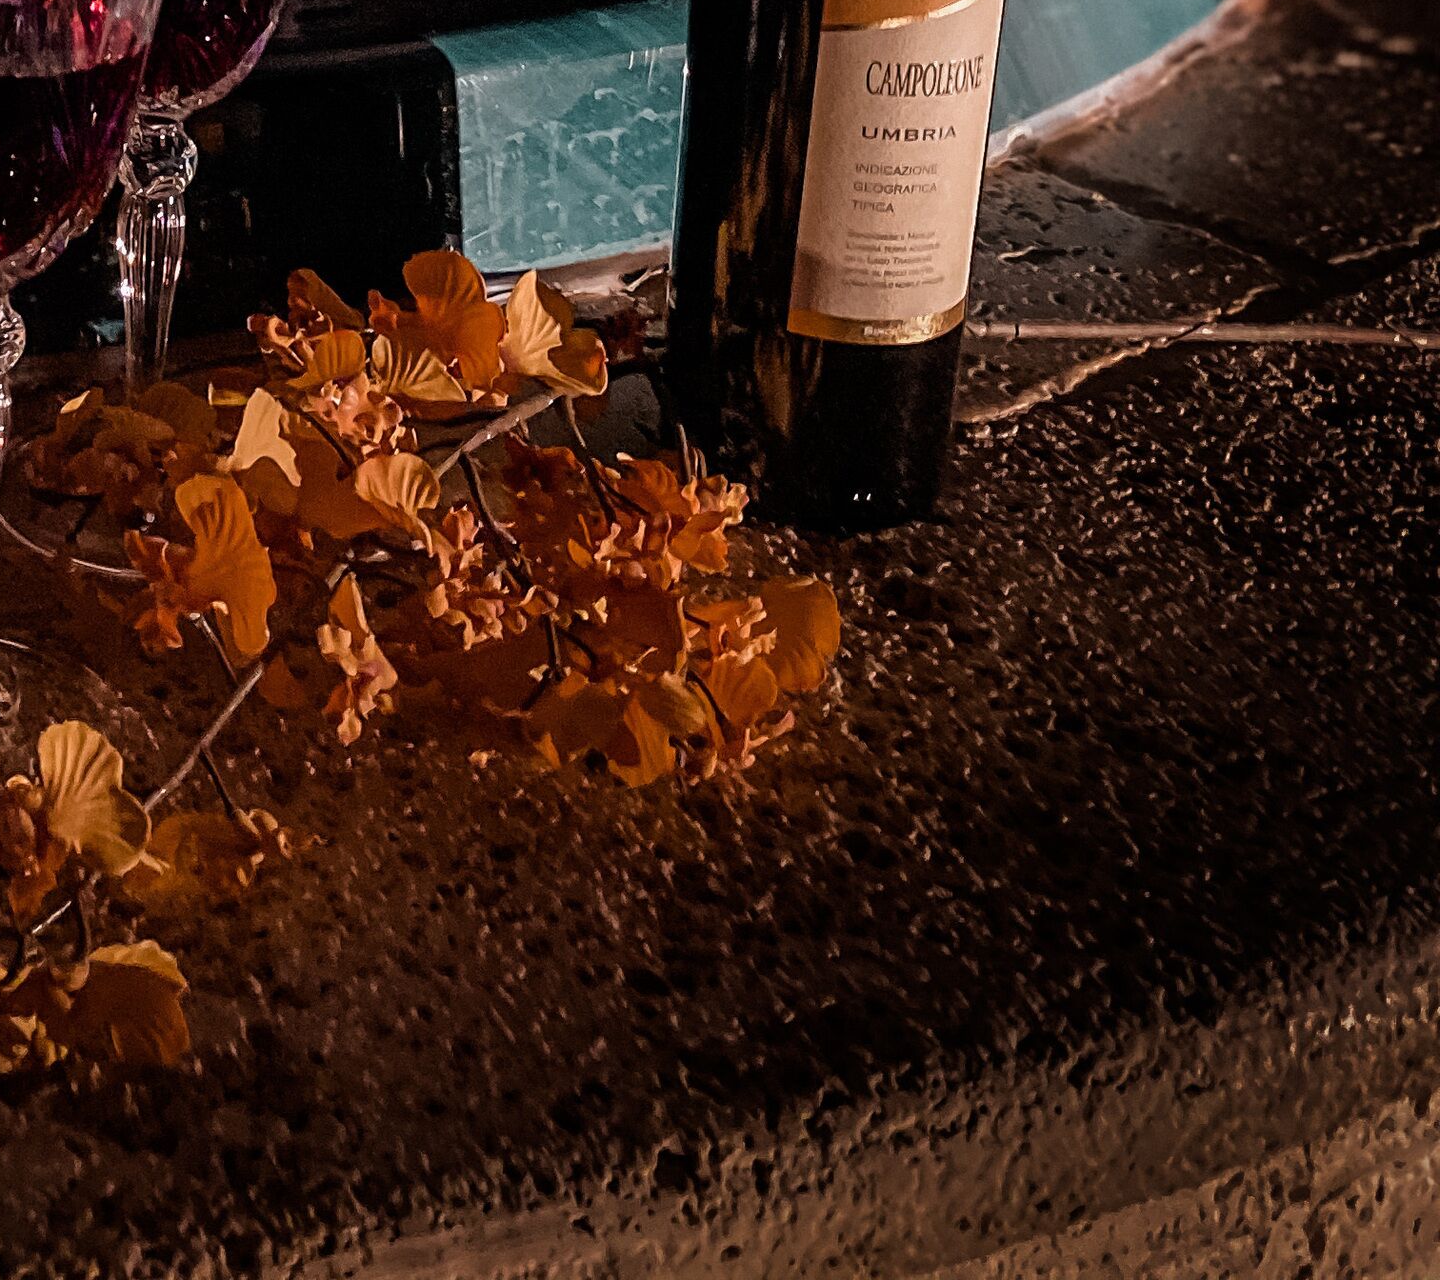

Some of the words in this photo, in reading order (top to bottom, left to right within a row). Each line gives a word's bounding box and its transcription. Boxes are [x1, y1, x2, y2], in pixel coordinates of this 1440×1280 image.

[866, 55, 984, 97] CAMPOLEONE
[861, 125, 957, 142] UMBRIA
[855, 162, 938, 176] INDICAZIONE
[853, 182, 938, 195] GEOGRAFICA
[851, 199, 895, 213] TIPICA
